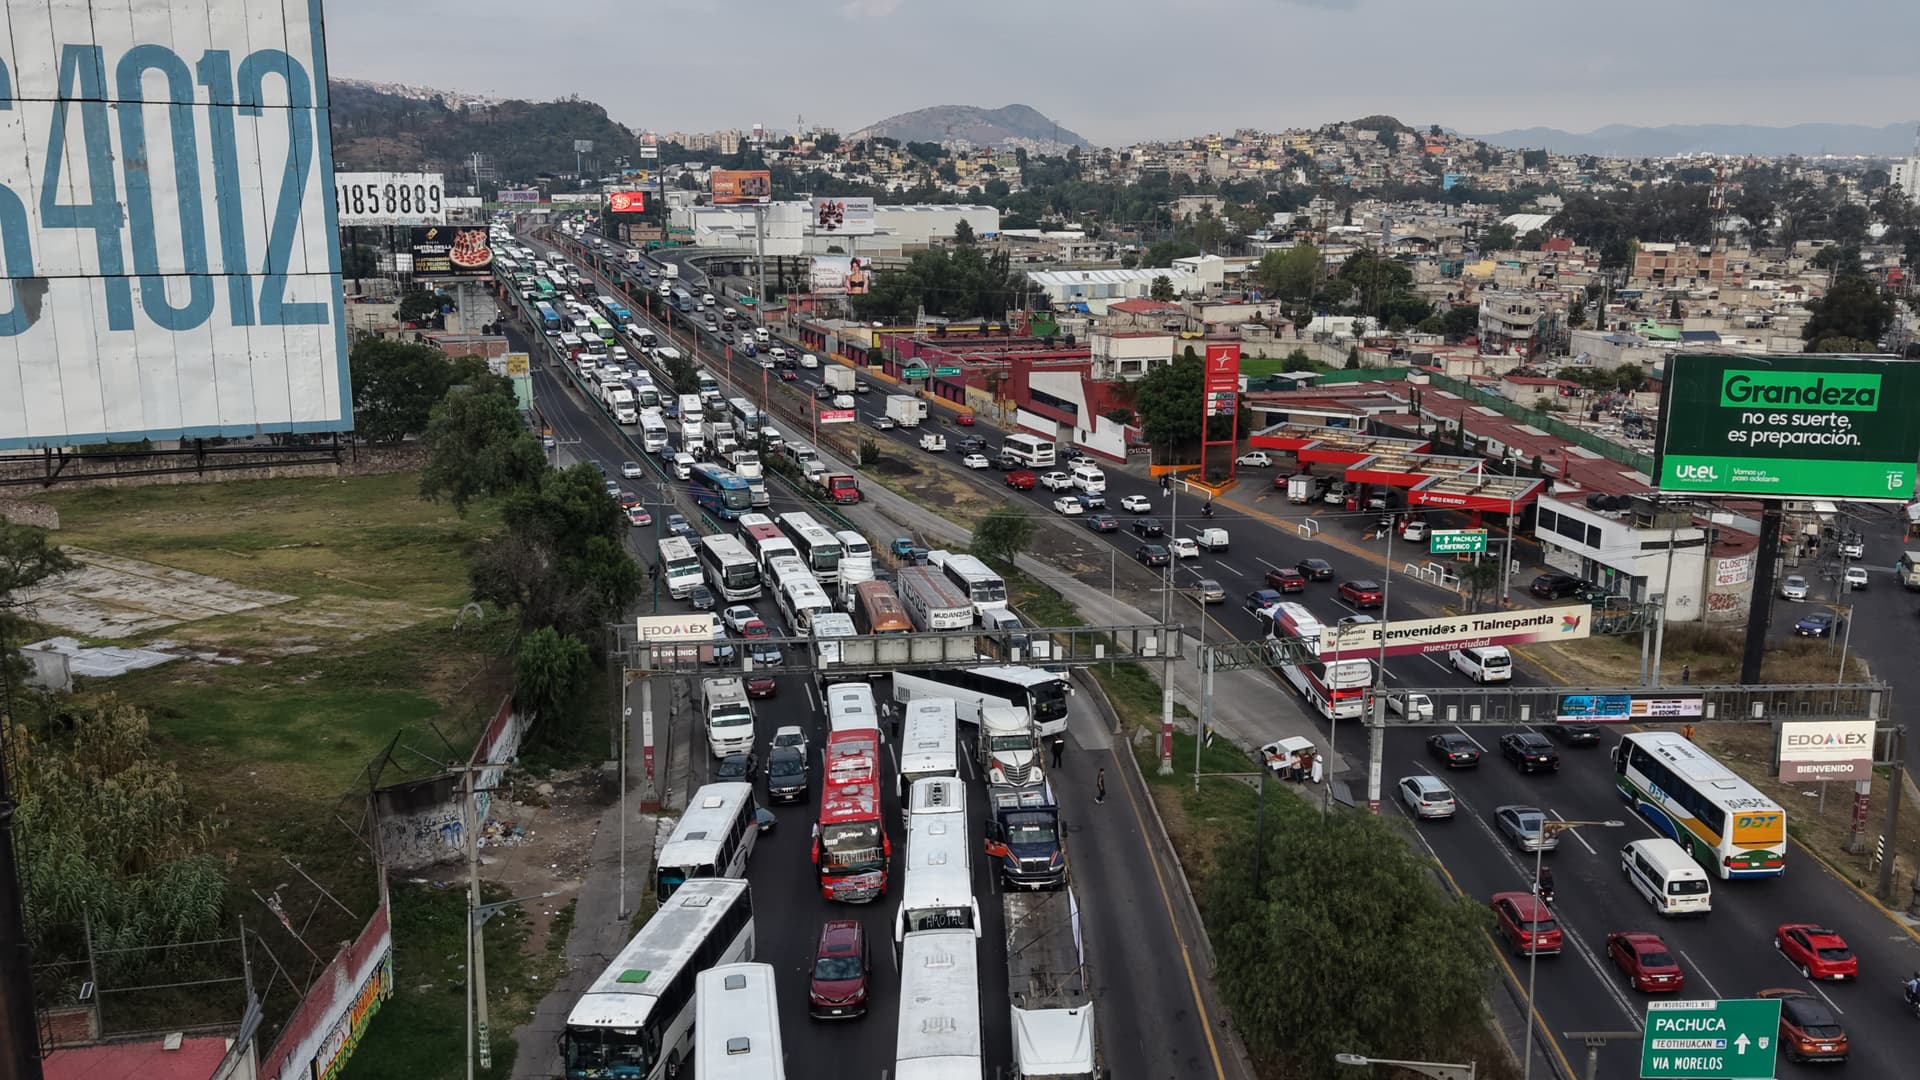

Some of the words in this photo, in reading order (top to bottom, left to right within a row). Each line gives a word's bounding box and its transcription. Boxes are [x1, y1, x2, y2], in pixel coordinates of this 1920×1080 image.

[1725, 375, 1876, 406] Grandeza
[1742, 412, 1764, 425] no
[1768, 413, 1788, 426] es
[1792, 412, 1852, 429] suerte,
[1727, 429, 1748, 442] es
[1750, 428, 1861, 448] preparación.
[934, 610, 970, 619] MUDANZAS
[1373, 624, 1455, 640] Benvenid@s
[1460, 624, 1468, 632] a
[1472, 614, 1554, 632] Tlalnepantla
[1423, 643, 1458, 652] nuestra
[1460, 638, 1490, 649] ciudad
[1797, 765, 1854, 773] BIENVENIDO
[1655, 1018, 1726, 1031] PACHUCA
[1656, 1040, 1713, 1048] TEOTIHUACAN
[1652, 1057, 1669, 1070] VIA
[1674, 1057, 1723, 1070] MORELOS
